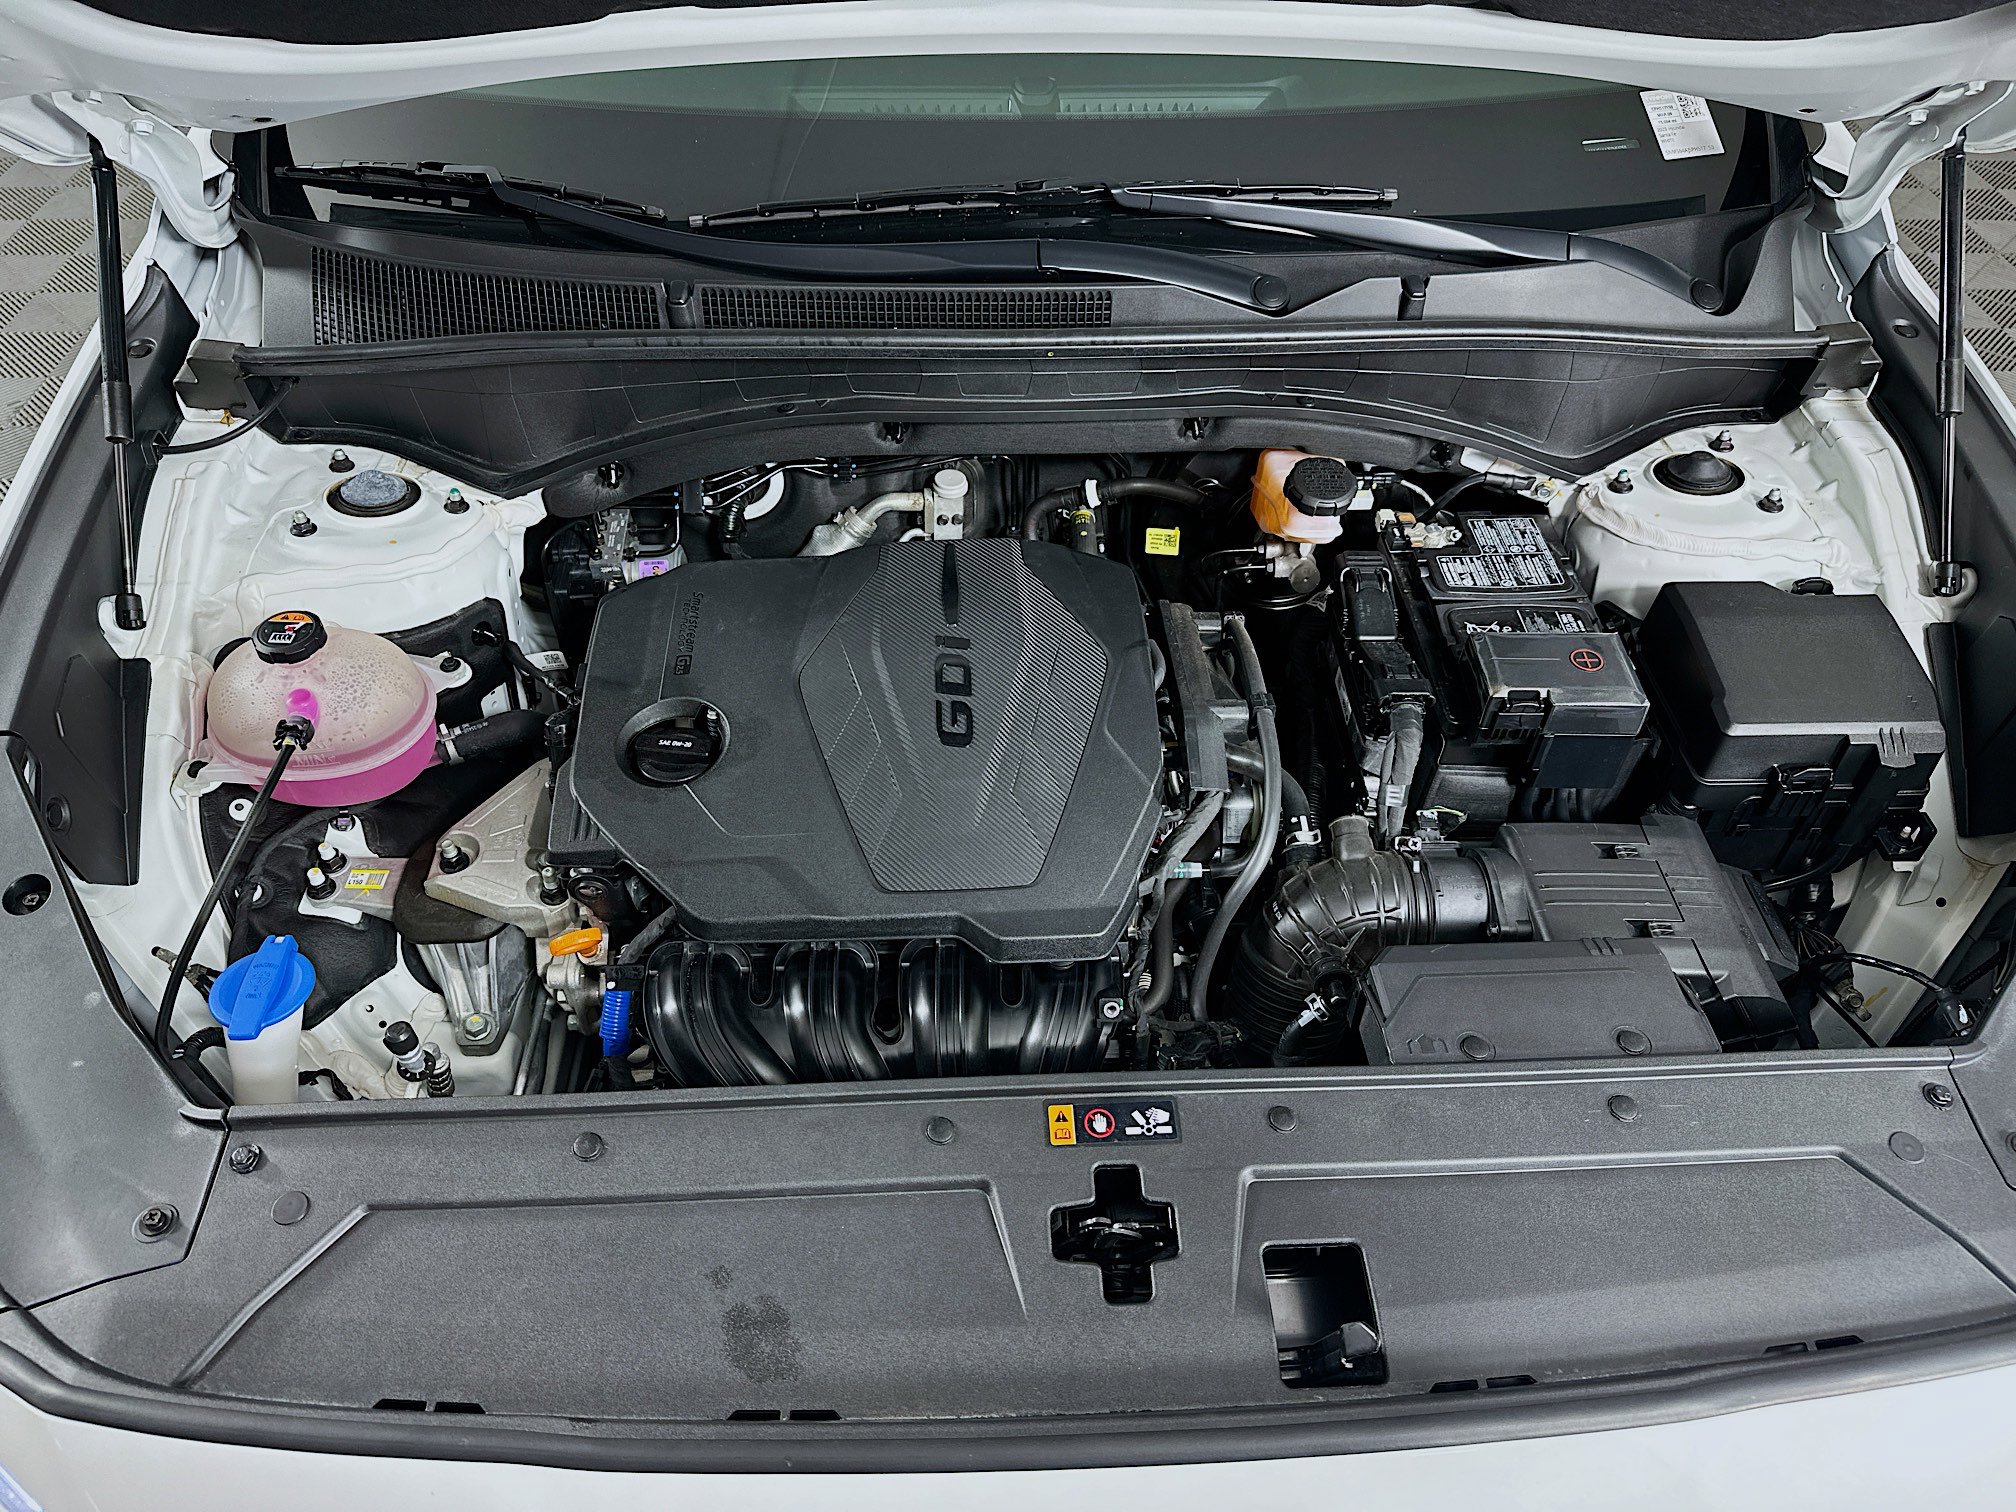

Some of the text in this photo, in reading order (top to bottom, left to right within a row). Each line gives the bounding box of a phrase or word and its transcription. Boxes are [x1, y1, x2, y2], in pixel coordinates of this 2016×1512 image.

[678, 598, 691, 653] TECHNOLOGY
[685, 591, 704, 653] Smartstream
[294, 753, 326, 767] MIN
[671, 740, 693, 748] 0W-20
